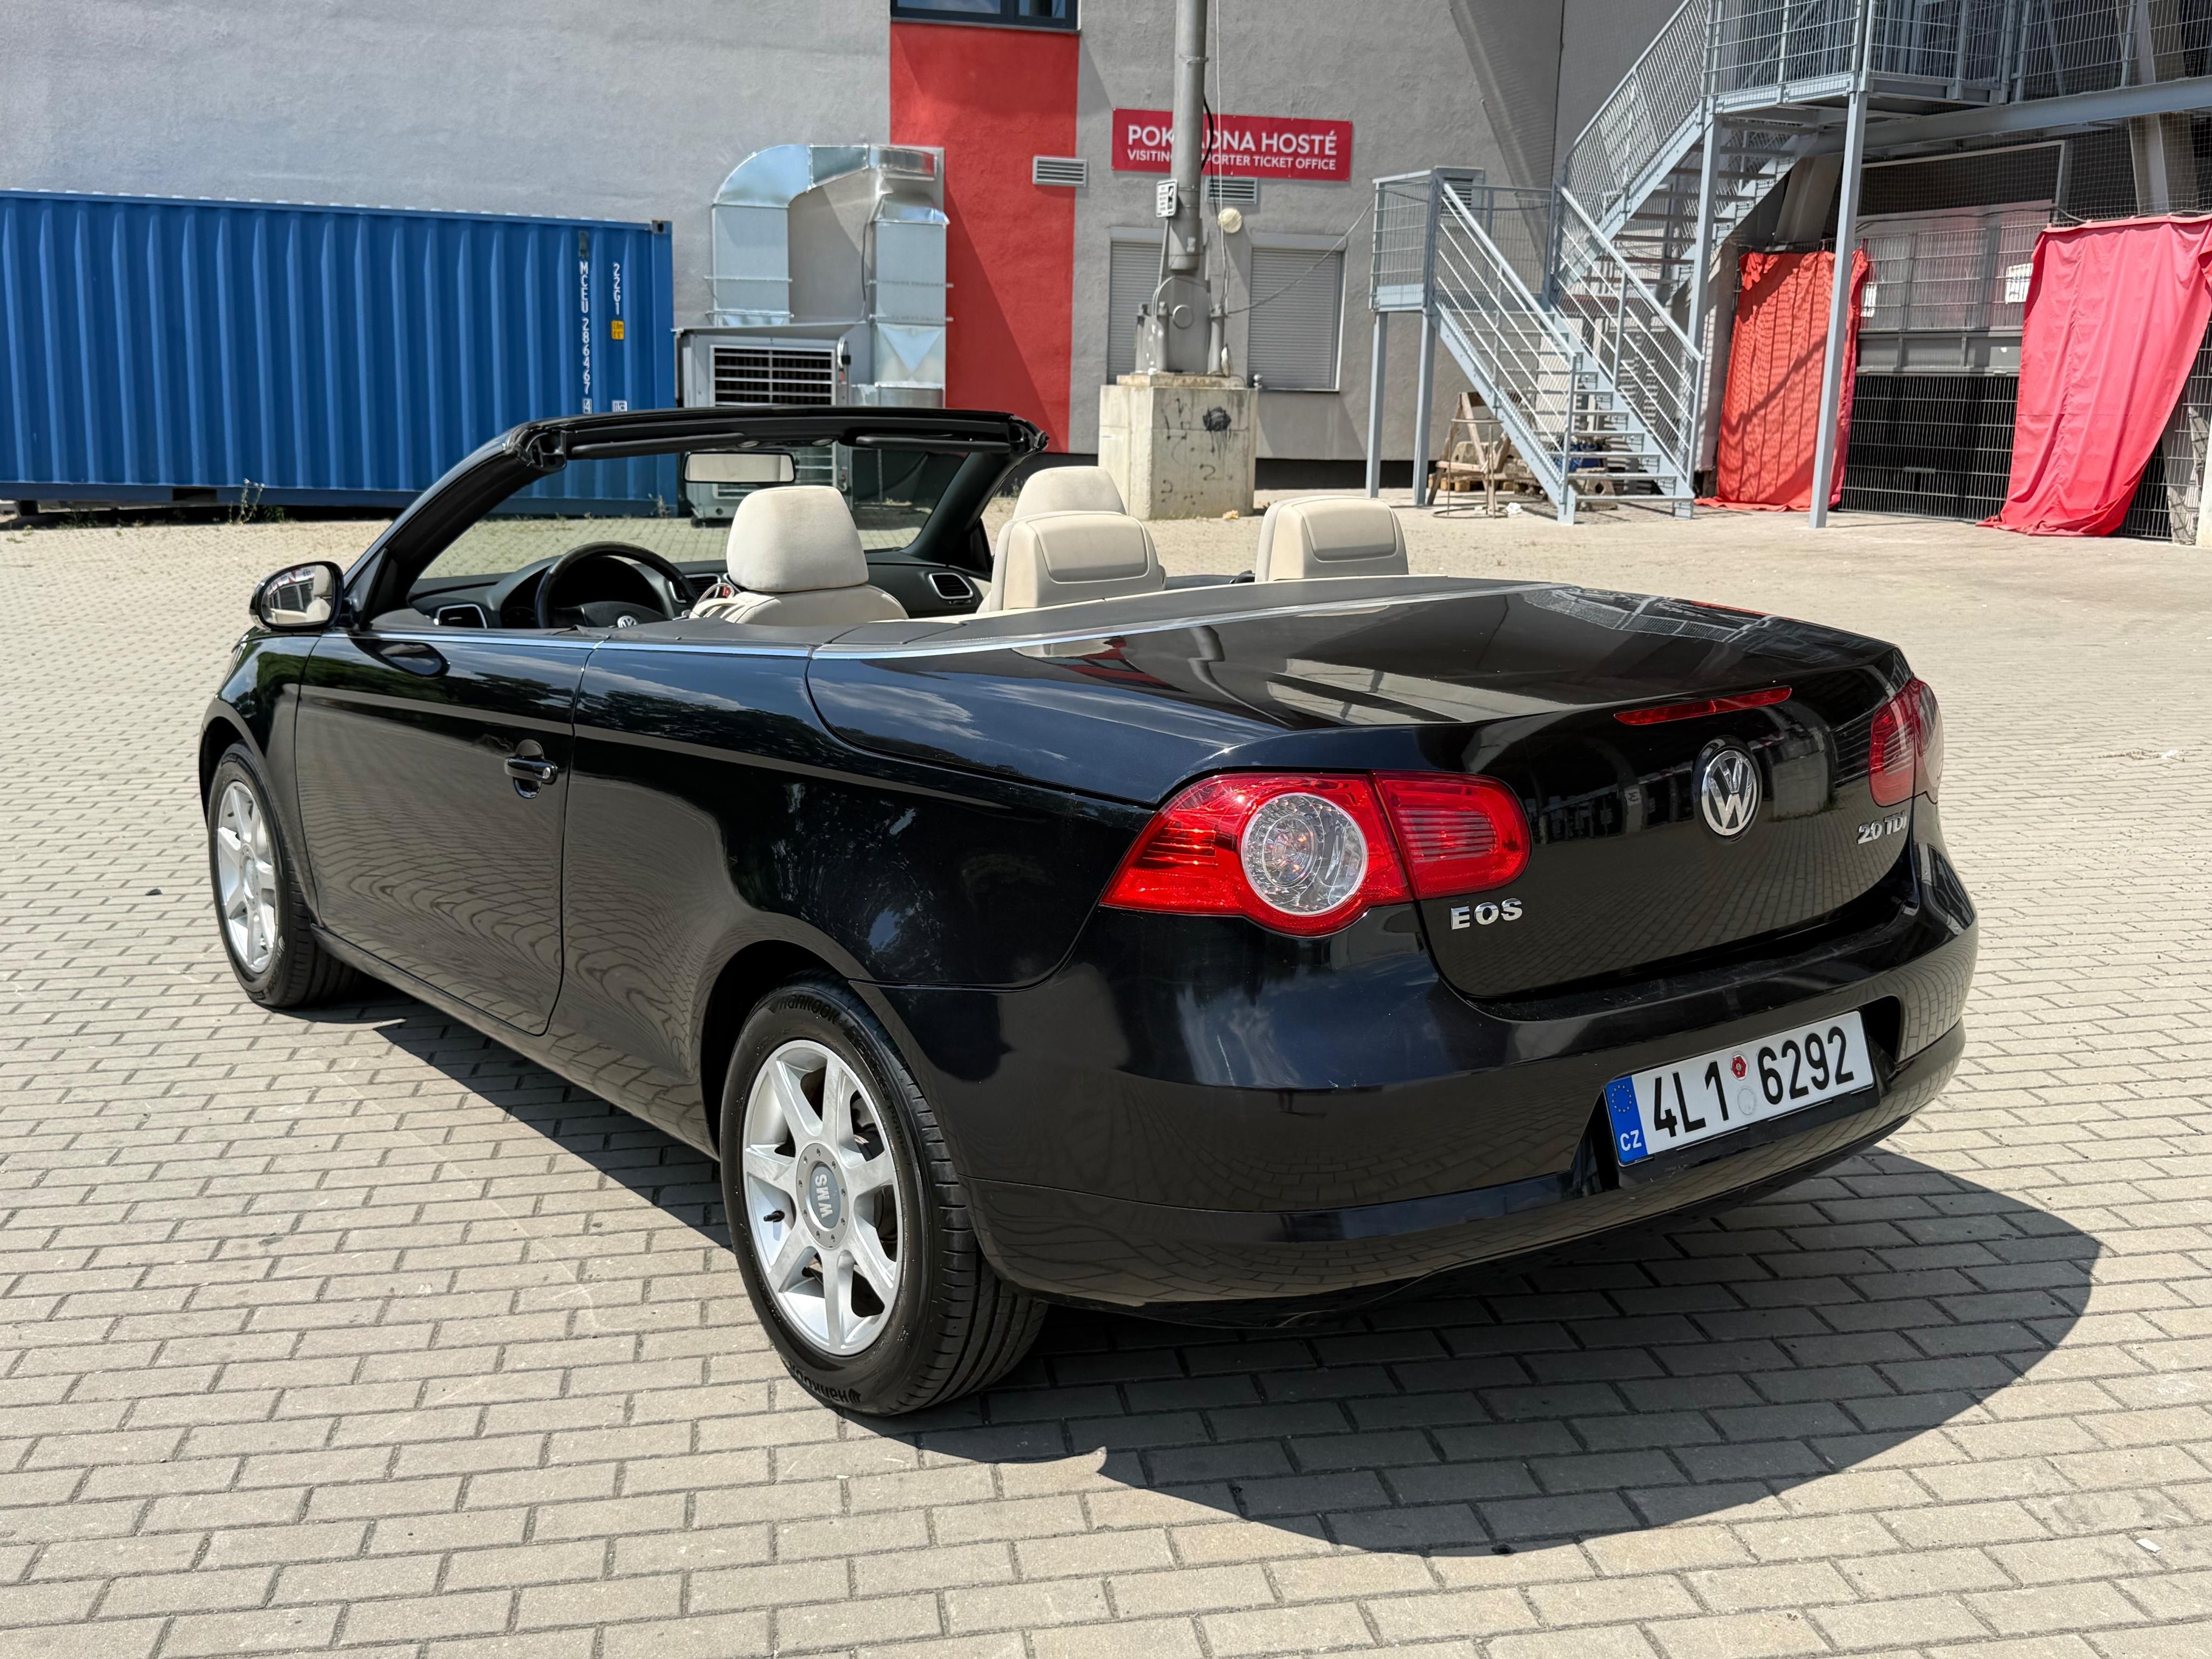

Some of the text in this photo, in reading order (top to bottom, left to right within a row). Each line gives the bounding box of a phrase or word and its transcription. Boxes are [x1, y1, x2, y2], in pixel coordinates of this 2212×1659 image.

[1128, 124, 1337, 156] POKDNA HOSTÉ
[1127, 149, 1172, 162] VISITIN
[1253, 155, 1294, 168] TICKET
[1295, 157, 1336, 170] OFFICE
[1884, 811, 1907, 835] TDI
[1451, 898, 1522, 930] EOS
[1654, 1027, 1854, 1138] 4L1 6292
[1620, 1129, 1642, 1151] CZ
[815, 1174, 833, 1218] WMS
